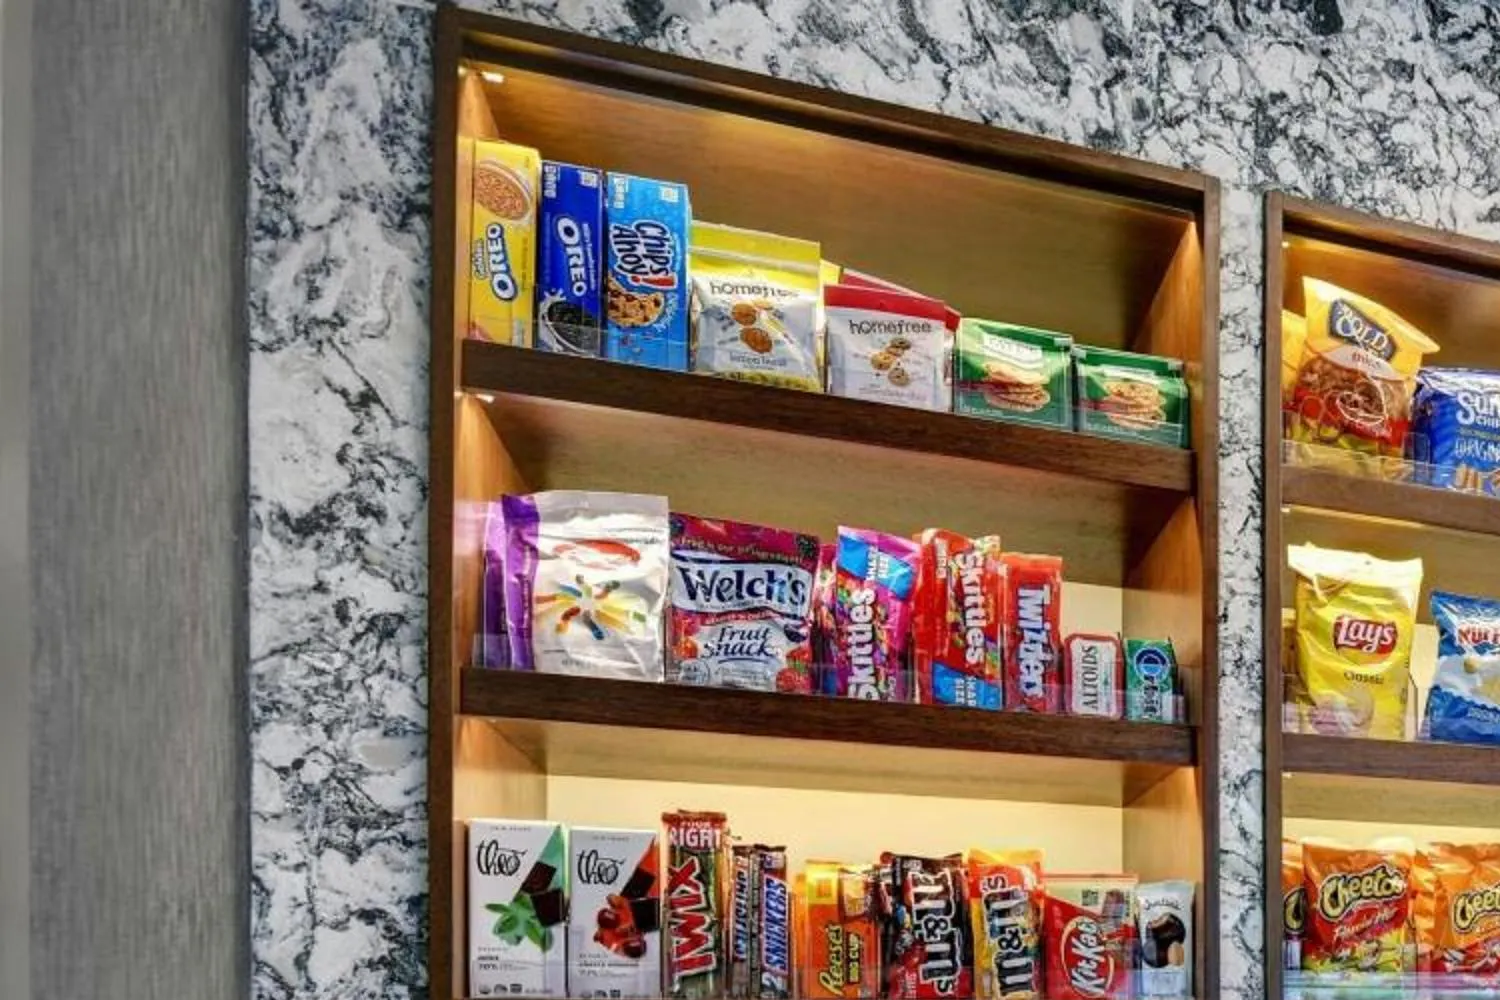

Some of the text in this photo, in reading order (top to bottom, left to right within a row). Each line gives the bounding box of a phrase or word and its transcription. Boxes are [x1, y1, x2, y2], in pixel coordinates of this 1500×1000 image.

[486, 223, 518, 301] OREO
[557, 217, 586, 297] OREO
[635, 222, 674, 277] Chips
[850, 318, 932, 335] homefree
[676, 566, 806, 605] Welch's
[955, 552, 988, 663] Skittles
[718, 625, 772, 643] Fruit
[850, 587, 877, 700] Skittles
[1336, 616, 1397, 653] Lay's
[1082, 644, 1100, 712] ALTOIDS
[667, 855, 716, 977] TWIX
[763, 877, 787, 971] SNICKERS
[1320, 866, 1406, 920] Cheetos
[818, 925, 844, 996] Reese's
